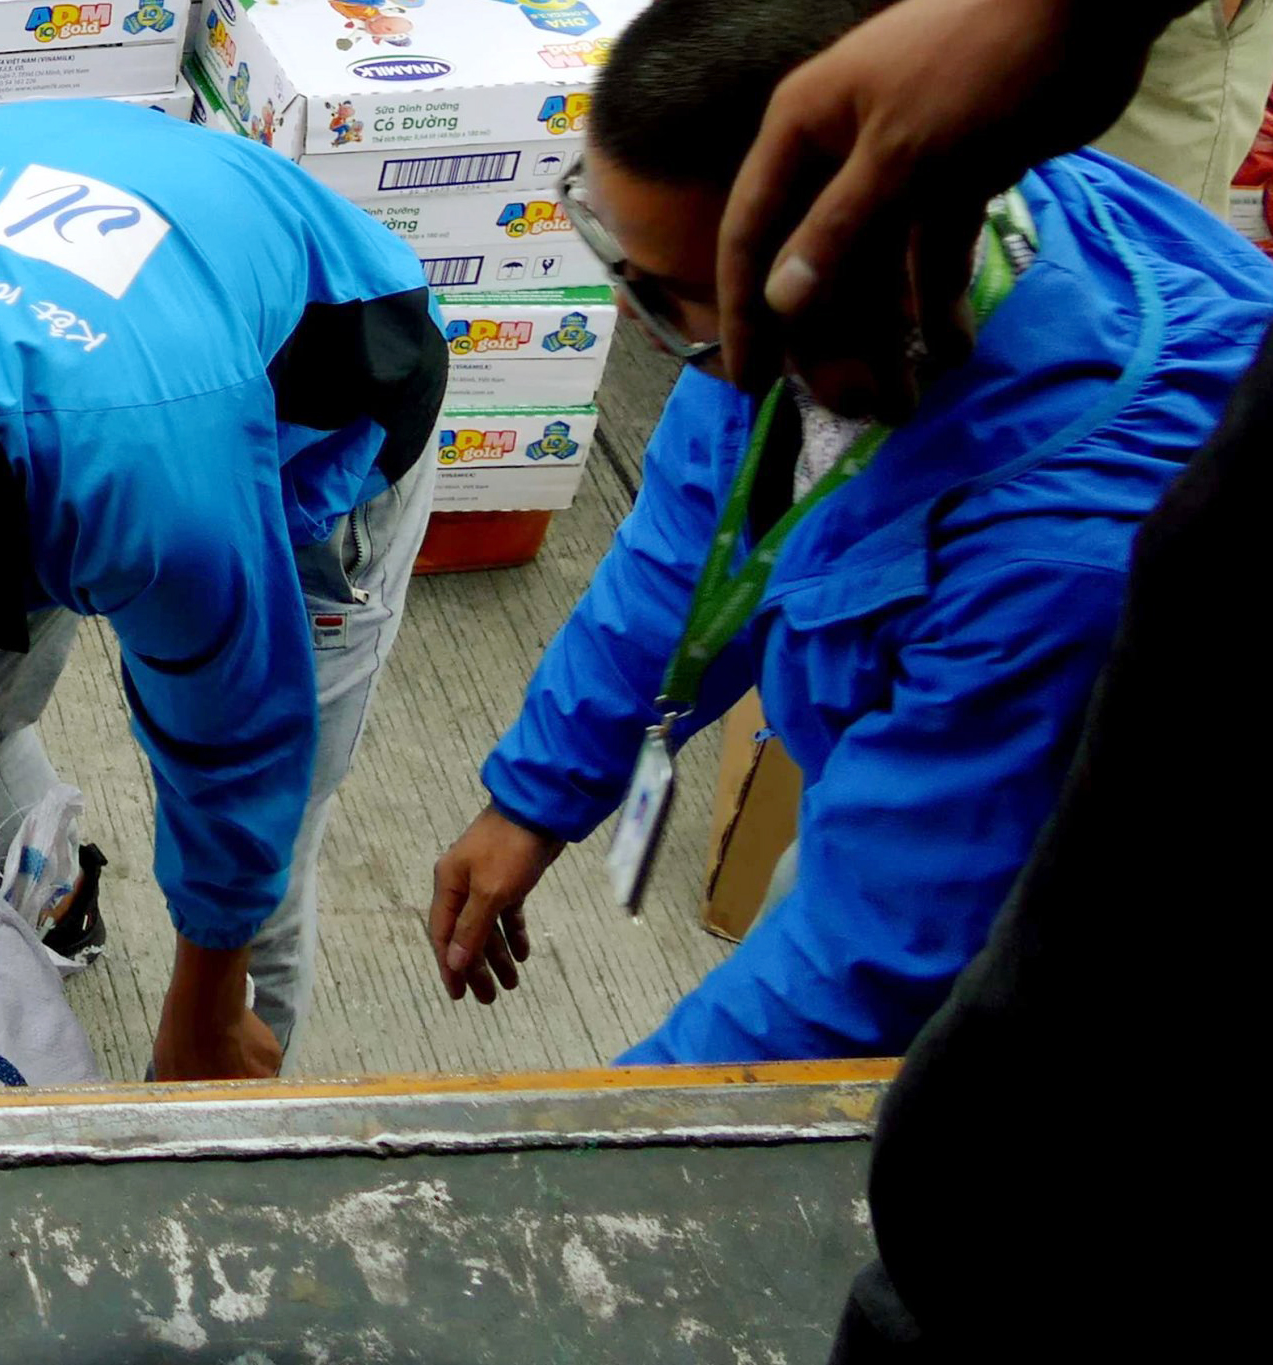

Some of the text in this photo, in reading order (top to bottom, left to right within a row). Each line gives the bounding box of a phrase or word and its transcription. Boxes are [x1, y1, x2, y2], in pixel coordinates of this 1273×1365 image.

[59, 21, 101, 38] gold
[355, 62, 450, 78] VINAMILK
[375, 101, 459, 115] Sữa Dinh Dưỡng
[537, 92, 593, 122] AD
[373, 115, 458, 132] Có Đường
[387, 206, 420, 216] Dưỡng
[530, 219, 571, 234] gold
[477, 337, 519, 352] gold
[462, 446, 503, 461] gold
